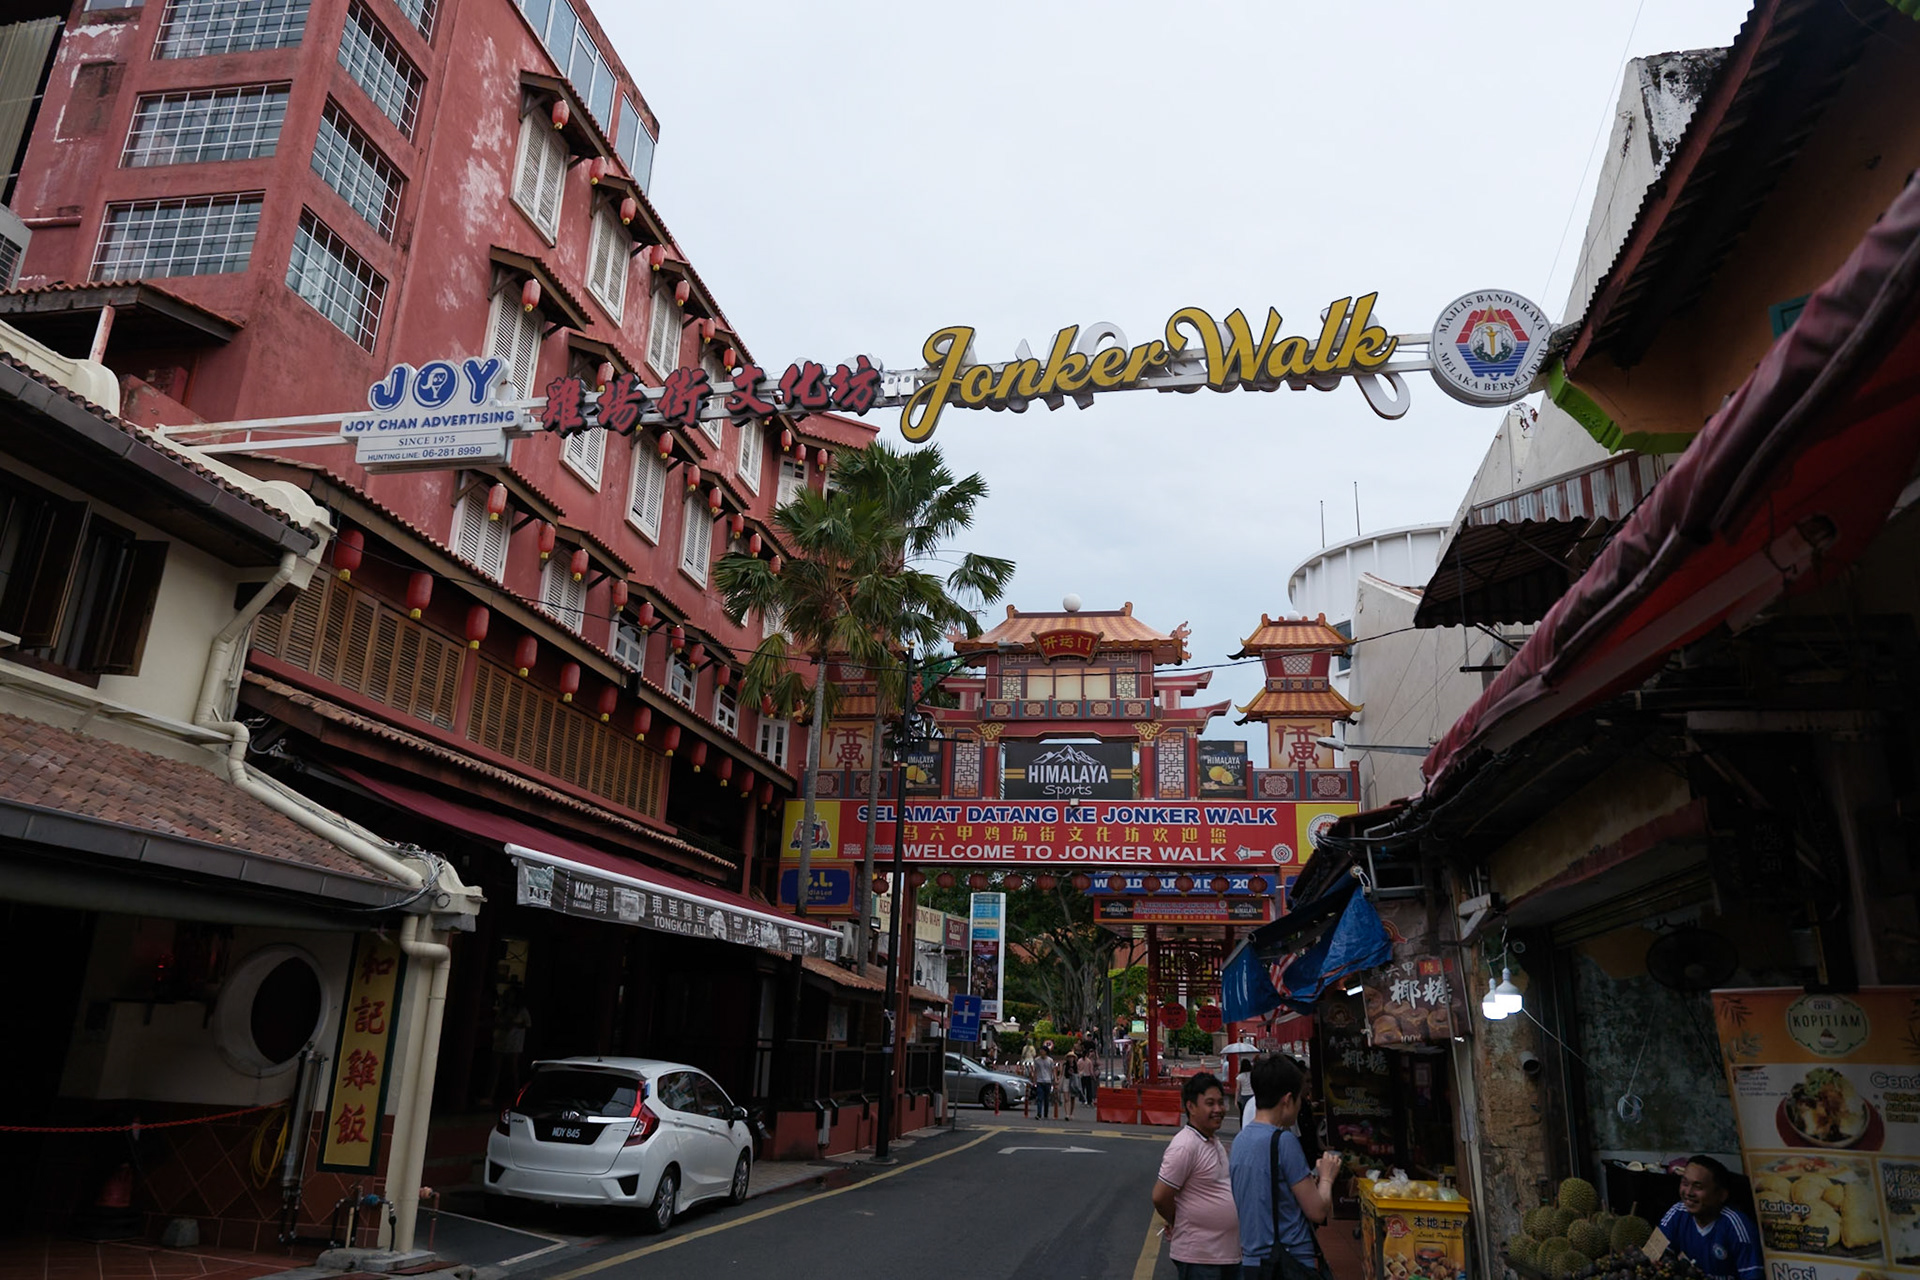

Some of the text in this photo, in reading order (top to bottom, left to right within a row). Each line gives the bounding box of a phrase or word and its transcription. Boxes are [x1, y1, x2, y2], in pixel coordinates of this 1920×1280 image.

[1439, 293, 1546, 334] MAJLIS BANDARAYA
[900, 291, 1398, 443] Jonker Walk
[1440, 349, 1548, 391] MELAKA BERSEJARAH
[369, 358, 500, 411] JOY
[345, 410, 515, 433] JOY CHAN ADVERTISING
[398, 434, 456, 447] SINCE 1975
[367, 446, 482, 461] HUNTING LINE: 06-281 8999
[1043, 634, 1092, 651] 开运门
[1207, 756, 1240, 764] HIMALAYA
[1028, 764, 1109, 784] HIMALAYA
[1042, 784, 1092, 798] Sports
[857, 806, 1277, 826] SELAMAT DATANG KE JONKER WALK
[902, 844, 1015, 860] WELCOME
[1020, 845, 1051, 860] TO
[1058, 845, 1152, 861] JONKER
[1159, 847, 1227, 861] WALK
[653, 915, 706, 937] TONGKAT ALI
[1792, 1014, 1861, 1028] KOPITIAM
[566, 1128, 581, 1139] 845
[1414, 1216, 1463, 1230] 本地土产
